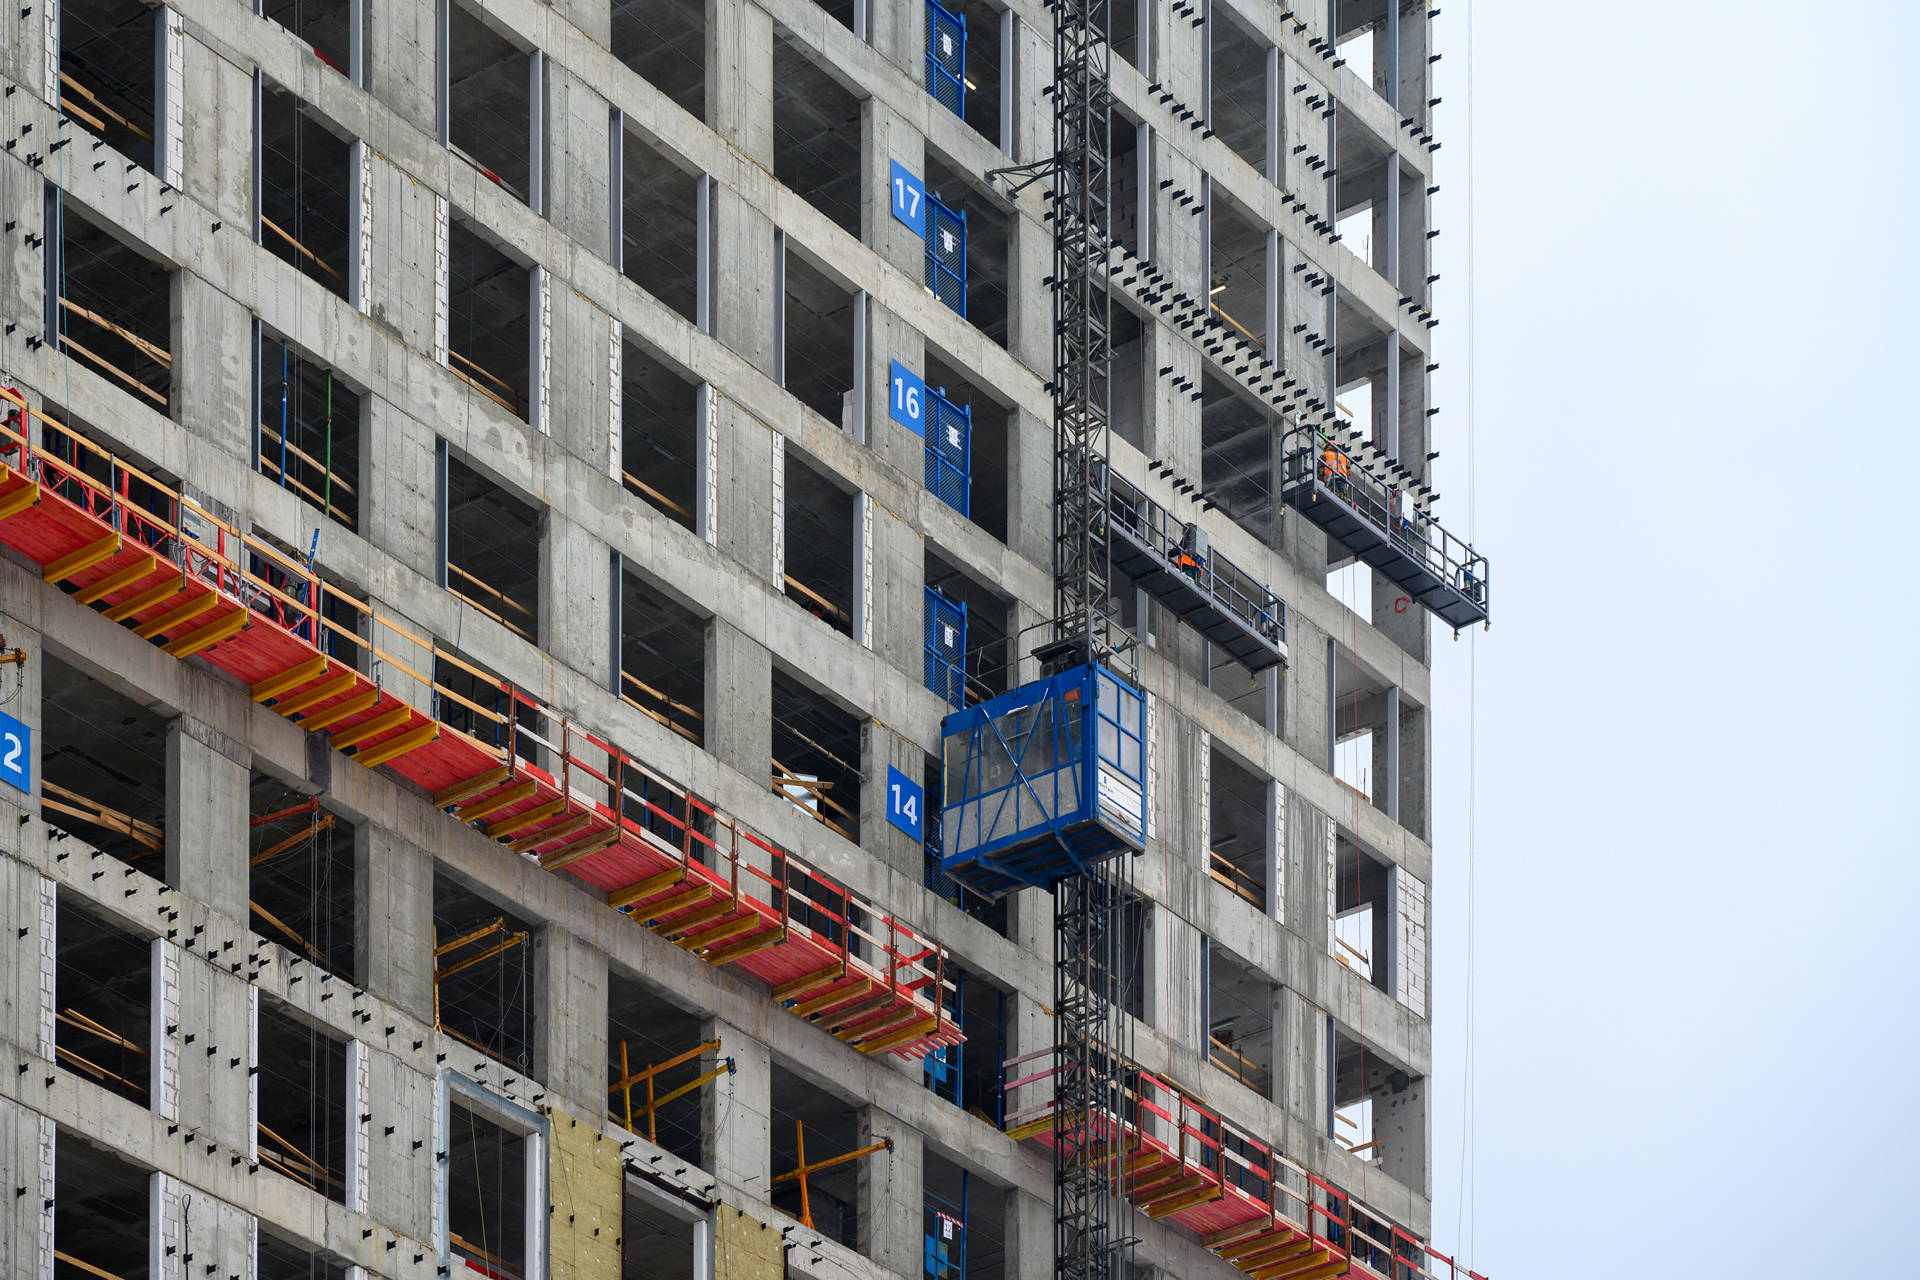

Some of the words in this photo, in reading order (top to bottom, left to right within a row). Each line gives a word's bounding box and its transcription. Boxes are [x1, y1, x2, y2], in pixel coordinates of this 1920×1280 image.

[895, 178, 920, 219] 17
[895, 377, 920, 419] 16
[3, 732, 23, 774] 2
[891, 784, 918, 826] 14
